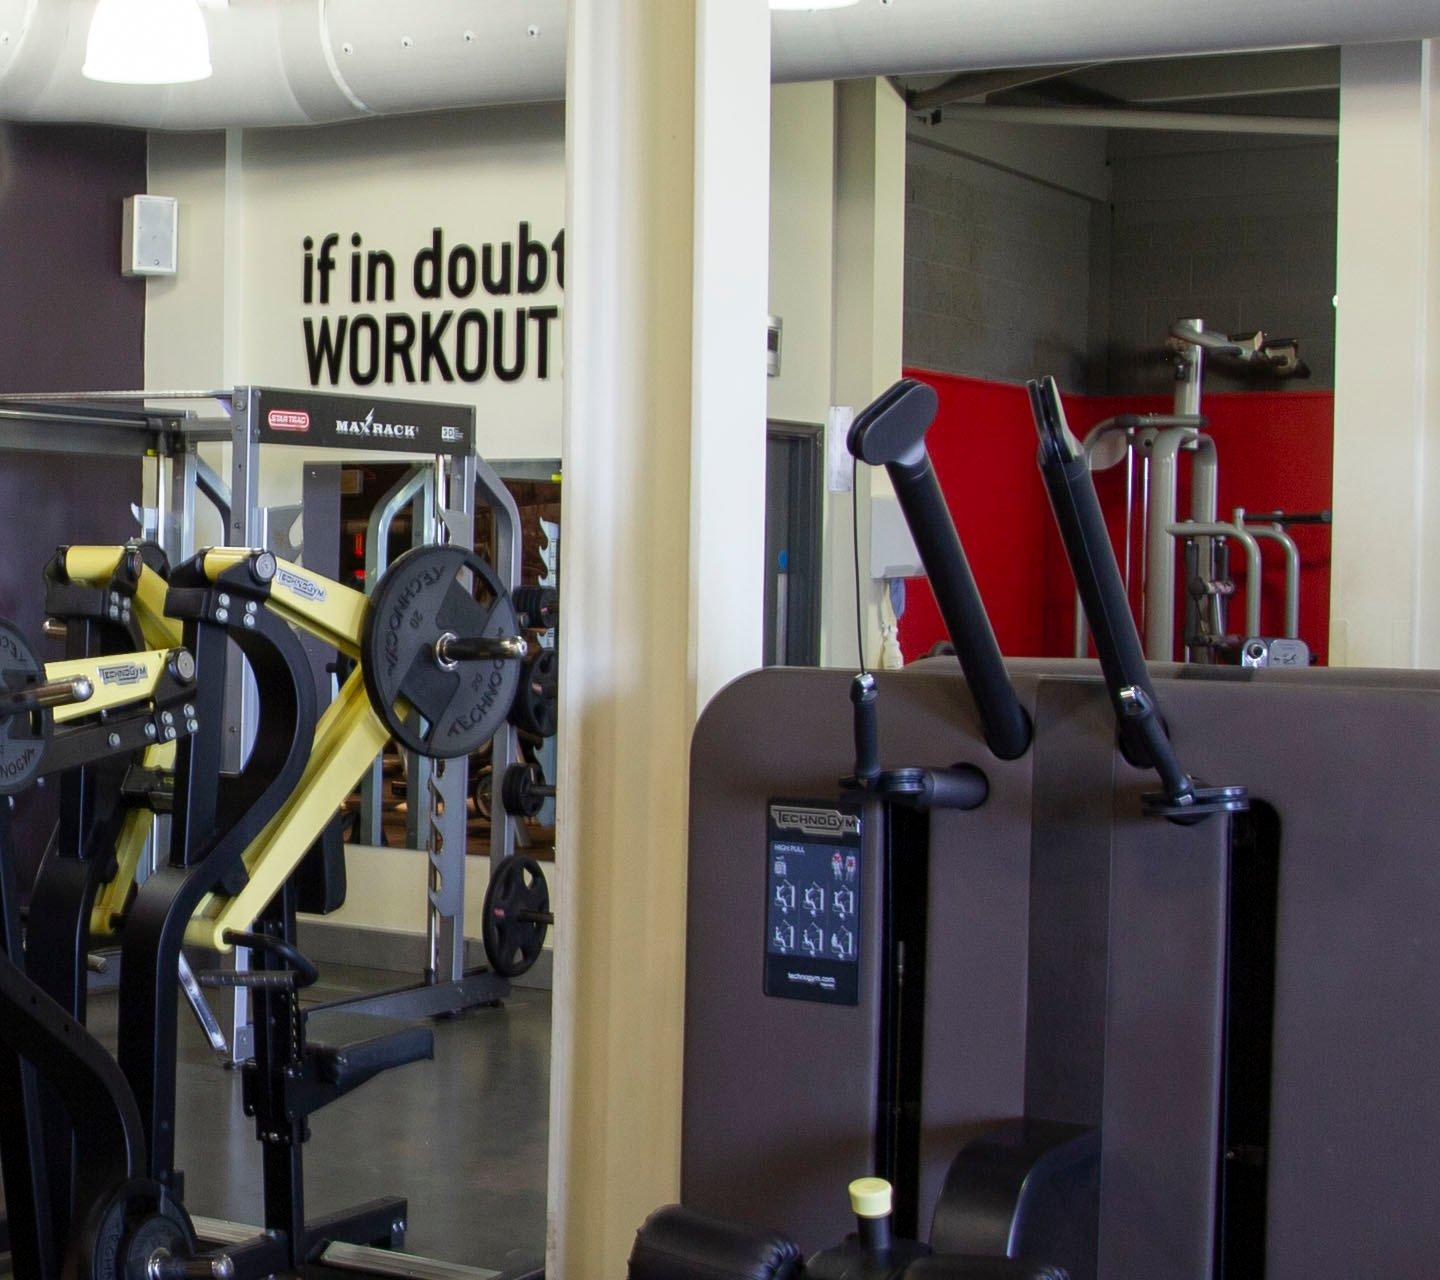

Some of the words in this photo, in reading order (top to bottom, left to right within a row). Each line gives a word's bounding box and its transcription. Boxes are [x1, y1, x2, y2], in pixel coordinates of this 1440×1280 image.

[302, 232, 340, 304] if
[350, 231, 396, 303] in
[302, 305, 558, 387] WORKOUT
[774, 809, 857, 831] TECHNOGYM
